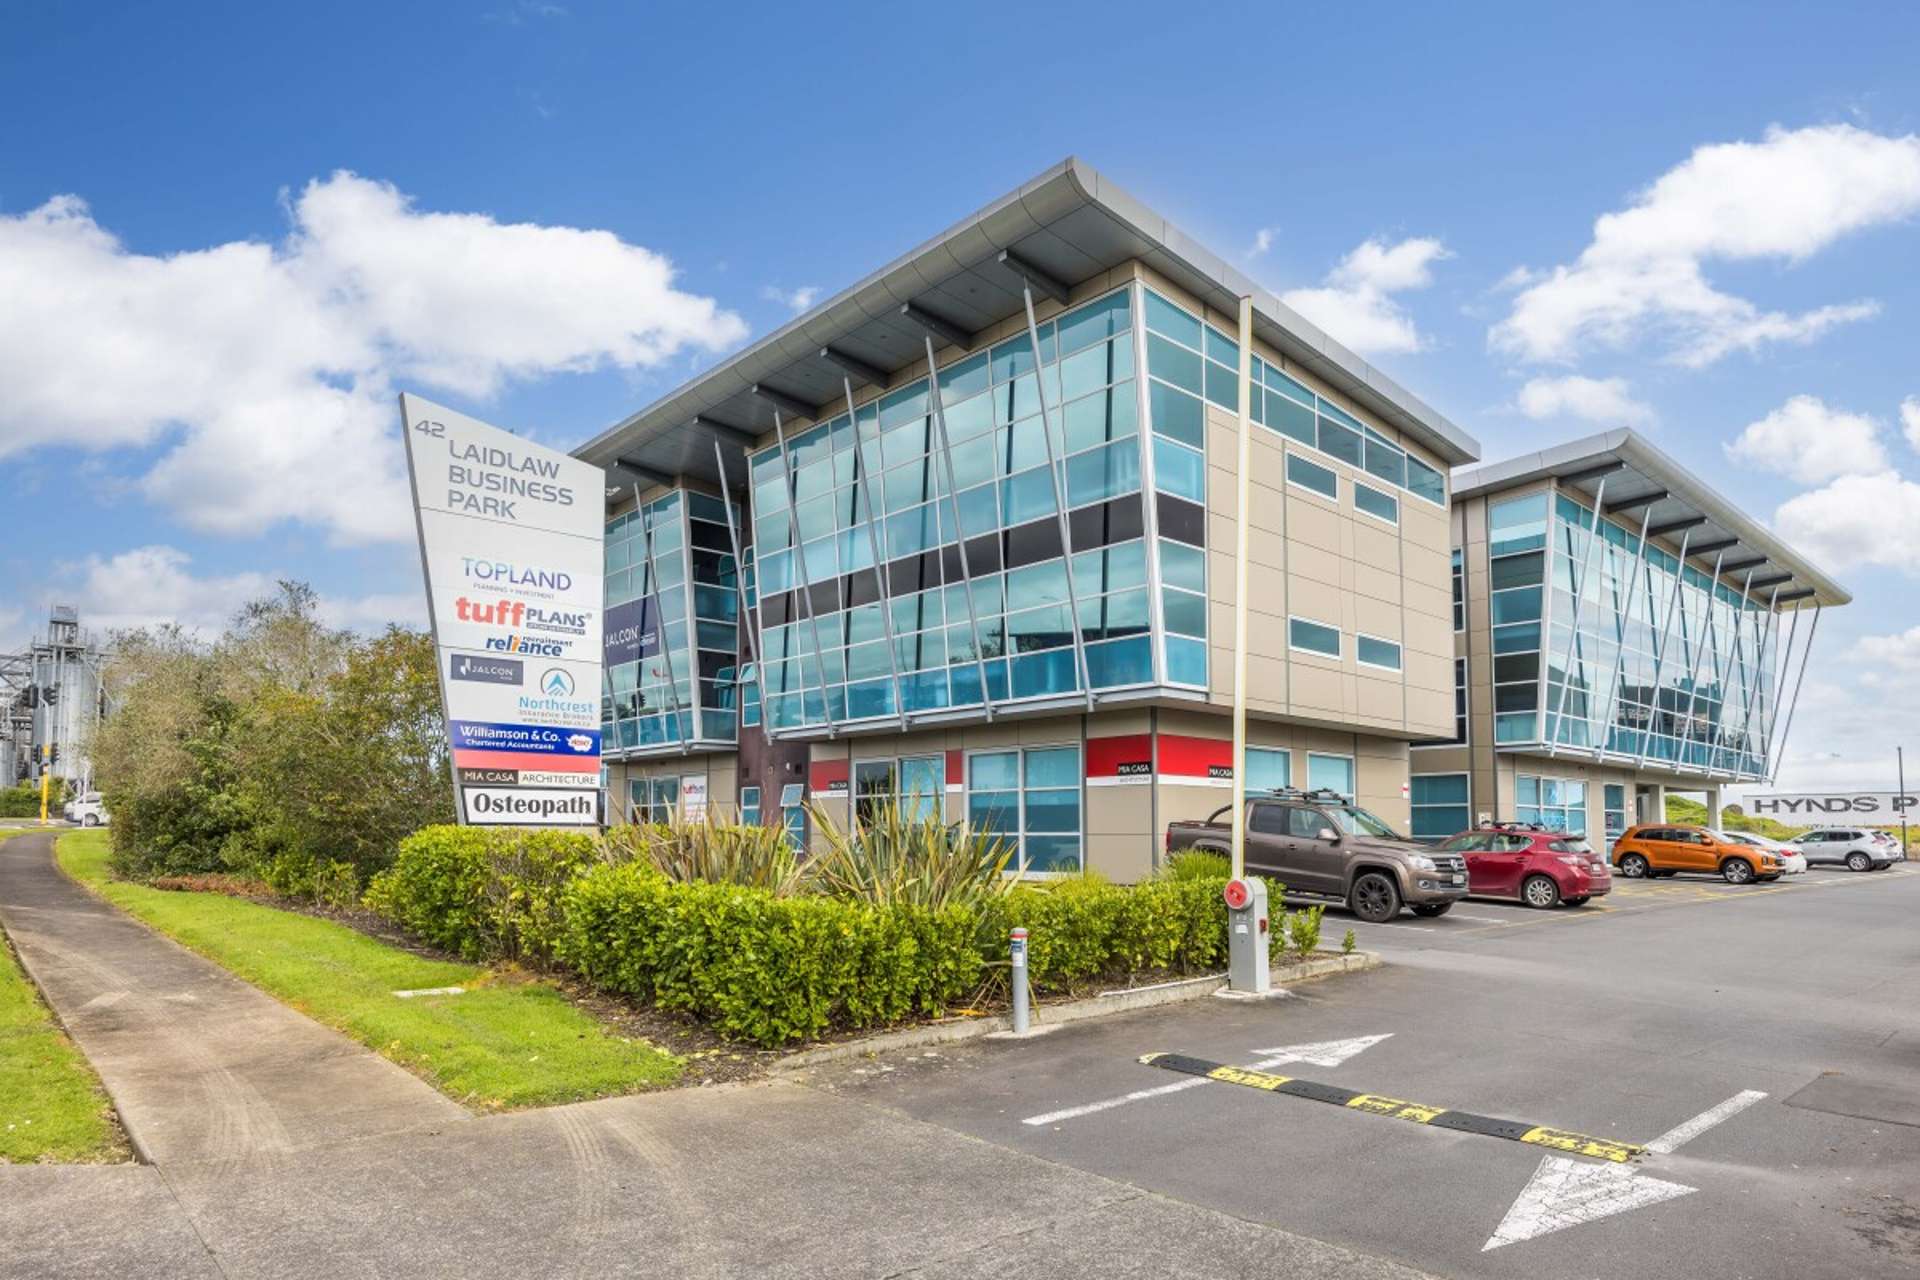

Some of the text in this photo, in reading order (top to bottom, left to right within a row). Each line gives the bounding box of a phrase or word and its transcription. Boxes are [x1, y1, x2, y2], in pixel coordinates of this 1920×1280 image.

[415, 420, 446, 439] 42
[449, 439, 560, 480] LAIDLAW
[448, 464, 574, 506] BUSINESS
[447, 490, 516, 519] PARK
[462, 556, 572, 591] TOPLAND
[455, 596, 526, 627] tuff
[485, 633, 562, 657] reliance
[472, 665, 513, 676] JALCON
[519, 697, 594, 714] Northcrest
[459, 725, 529, 740] Williamson
[531, 730, 540, 741] &
[542, 730, 561, 742] Co.
[465, 738, 506, 749] Chartered
[507, 740, 555, 750] Accountants
[464, 771, 515, 782] MIA CASA
[522, 773, 596, 785] ARCHITECTURE
[473, 792, 592, 818] Osteopath
[1755, 796, 1880, 814] HYNDS
